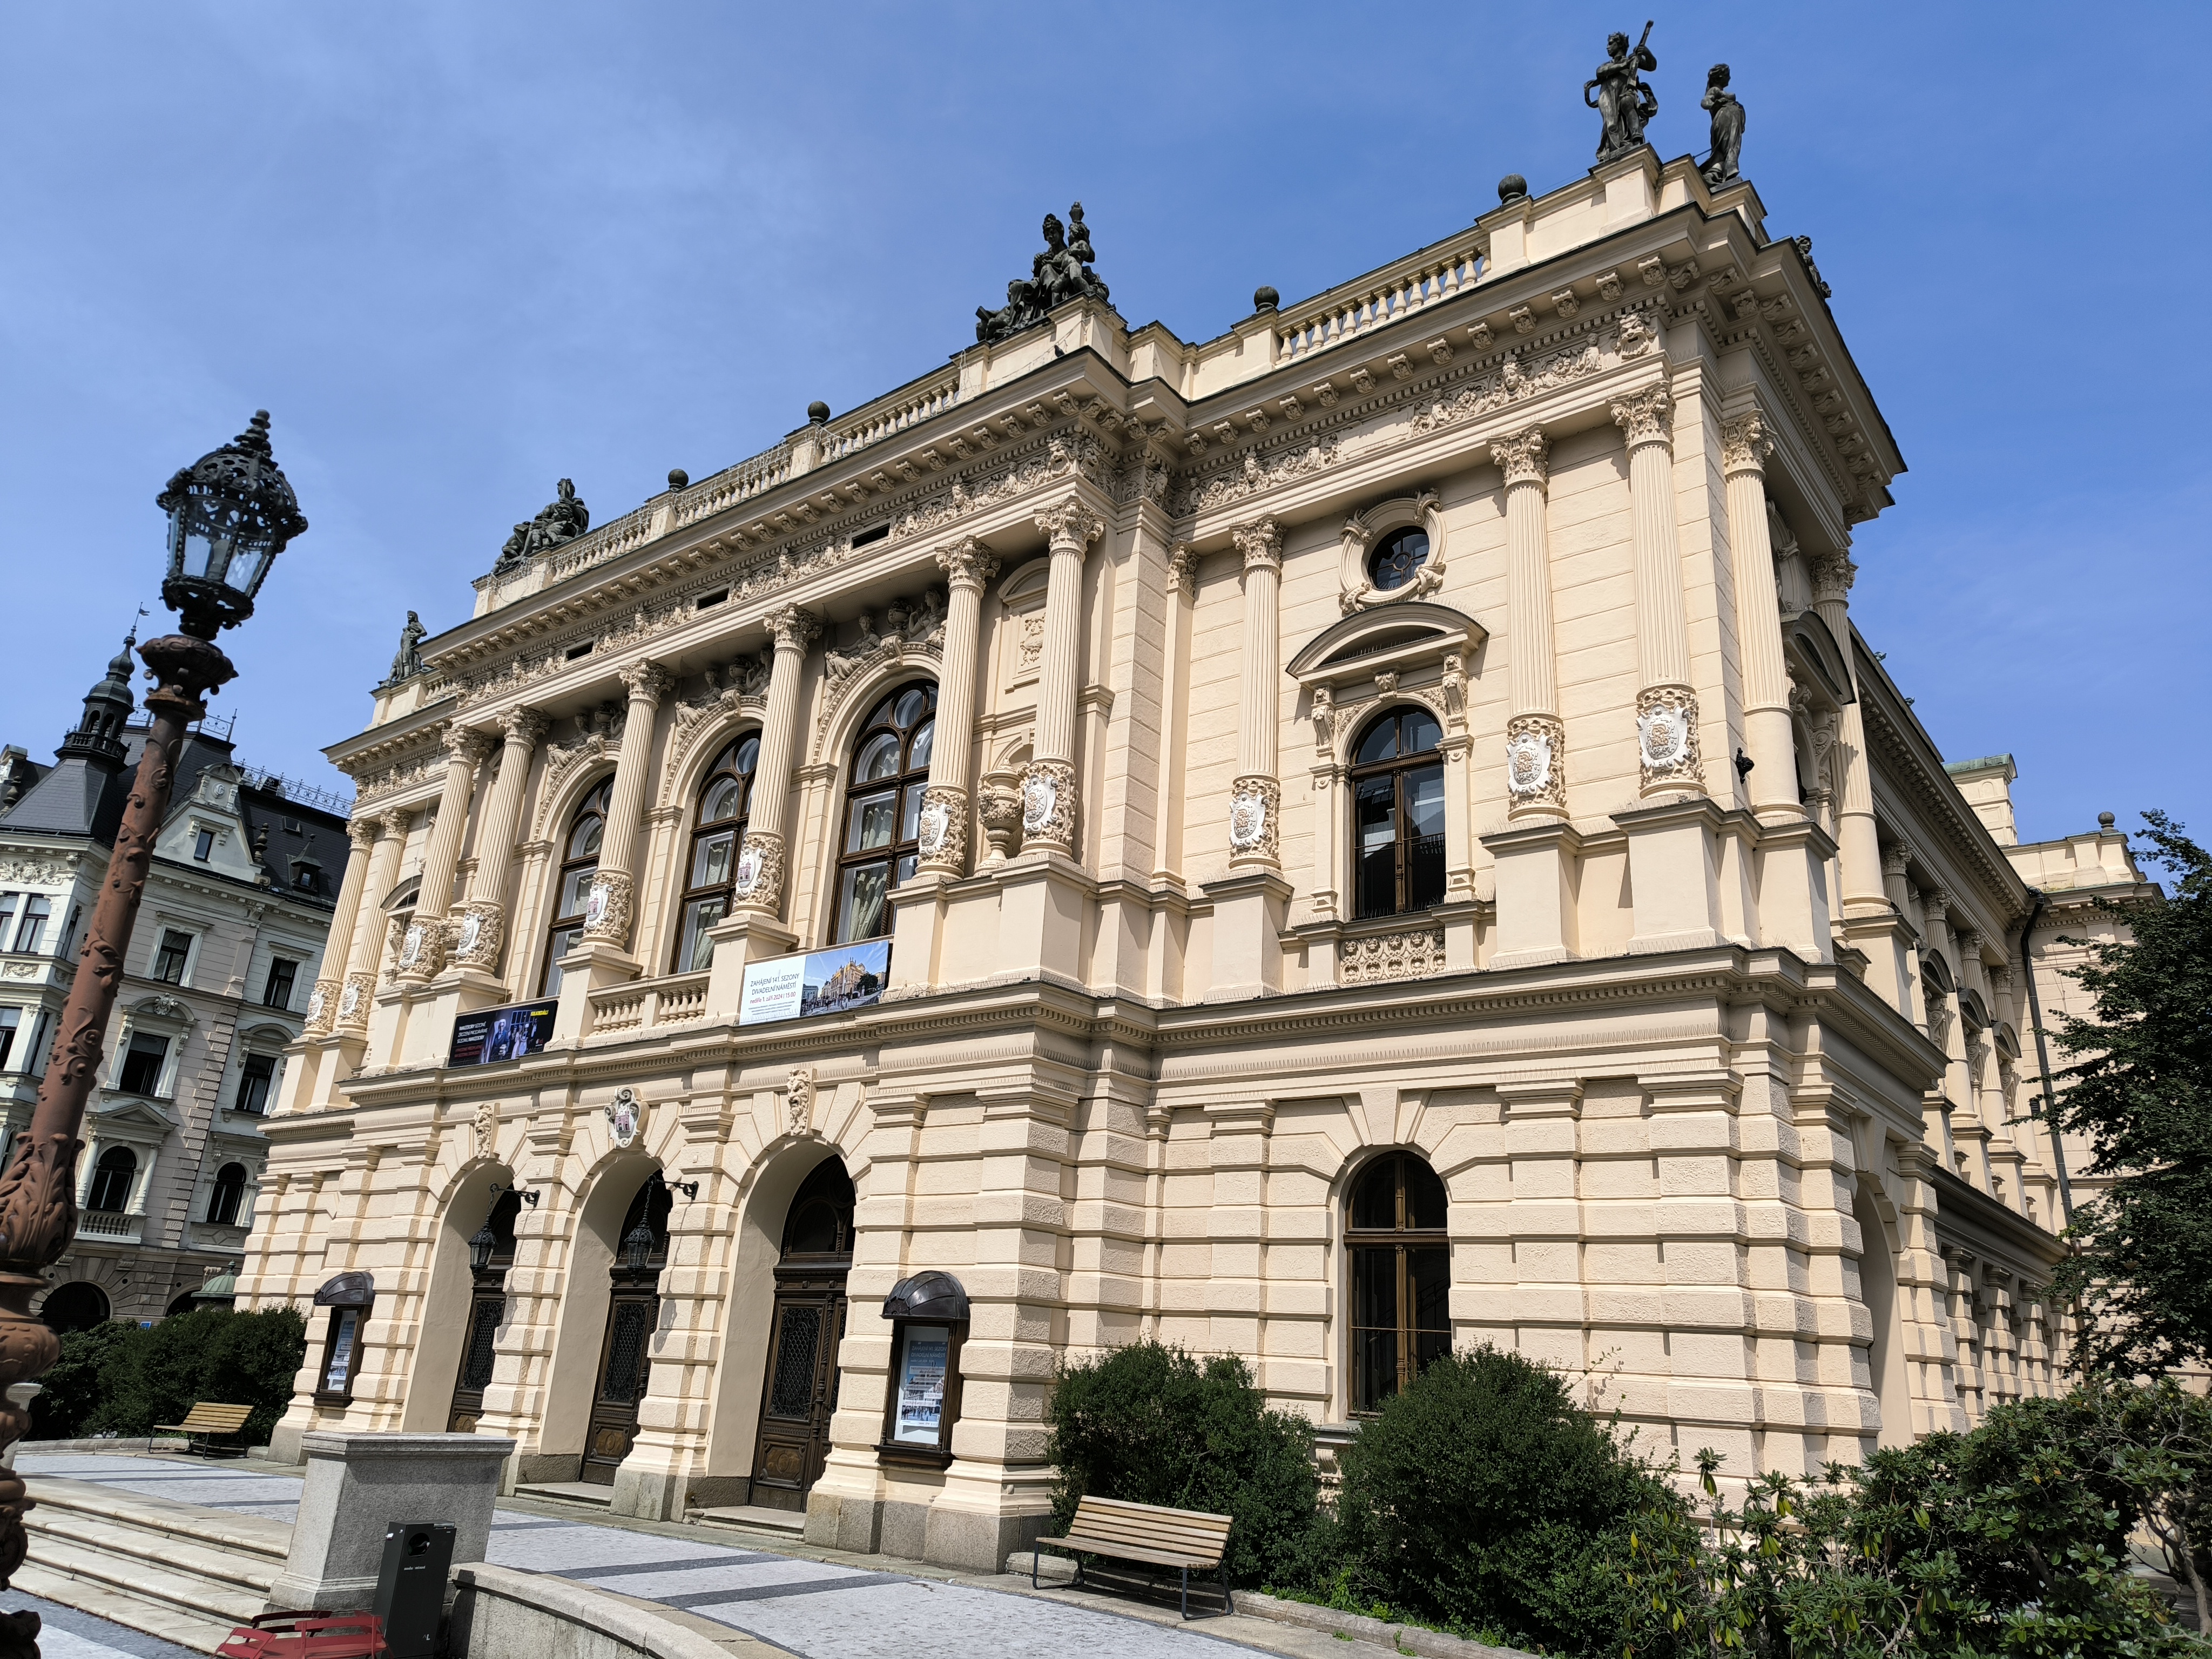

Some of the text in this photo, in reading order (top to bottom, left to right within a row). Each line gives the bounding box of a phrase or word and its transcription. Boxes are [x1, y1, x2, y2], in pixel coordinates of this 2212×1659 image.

[751, 976, 772, 987] ZAHÁJENÍ
[781, 973, 799, 982] SEZONY
[752, 981, 797, 995] DIVADELNÍ NÁMĚSTÍ
